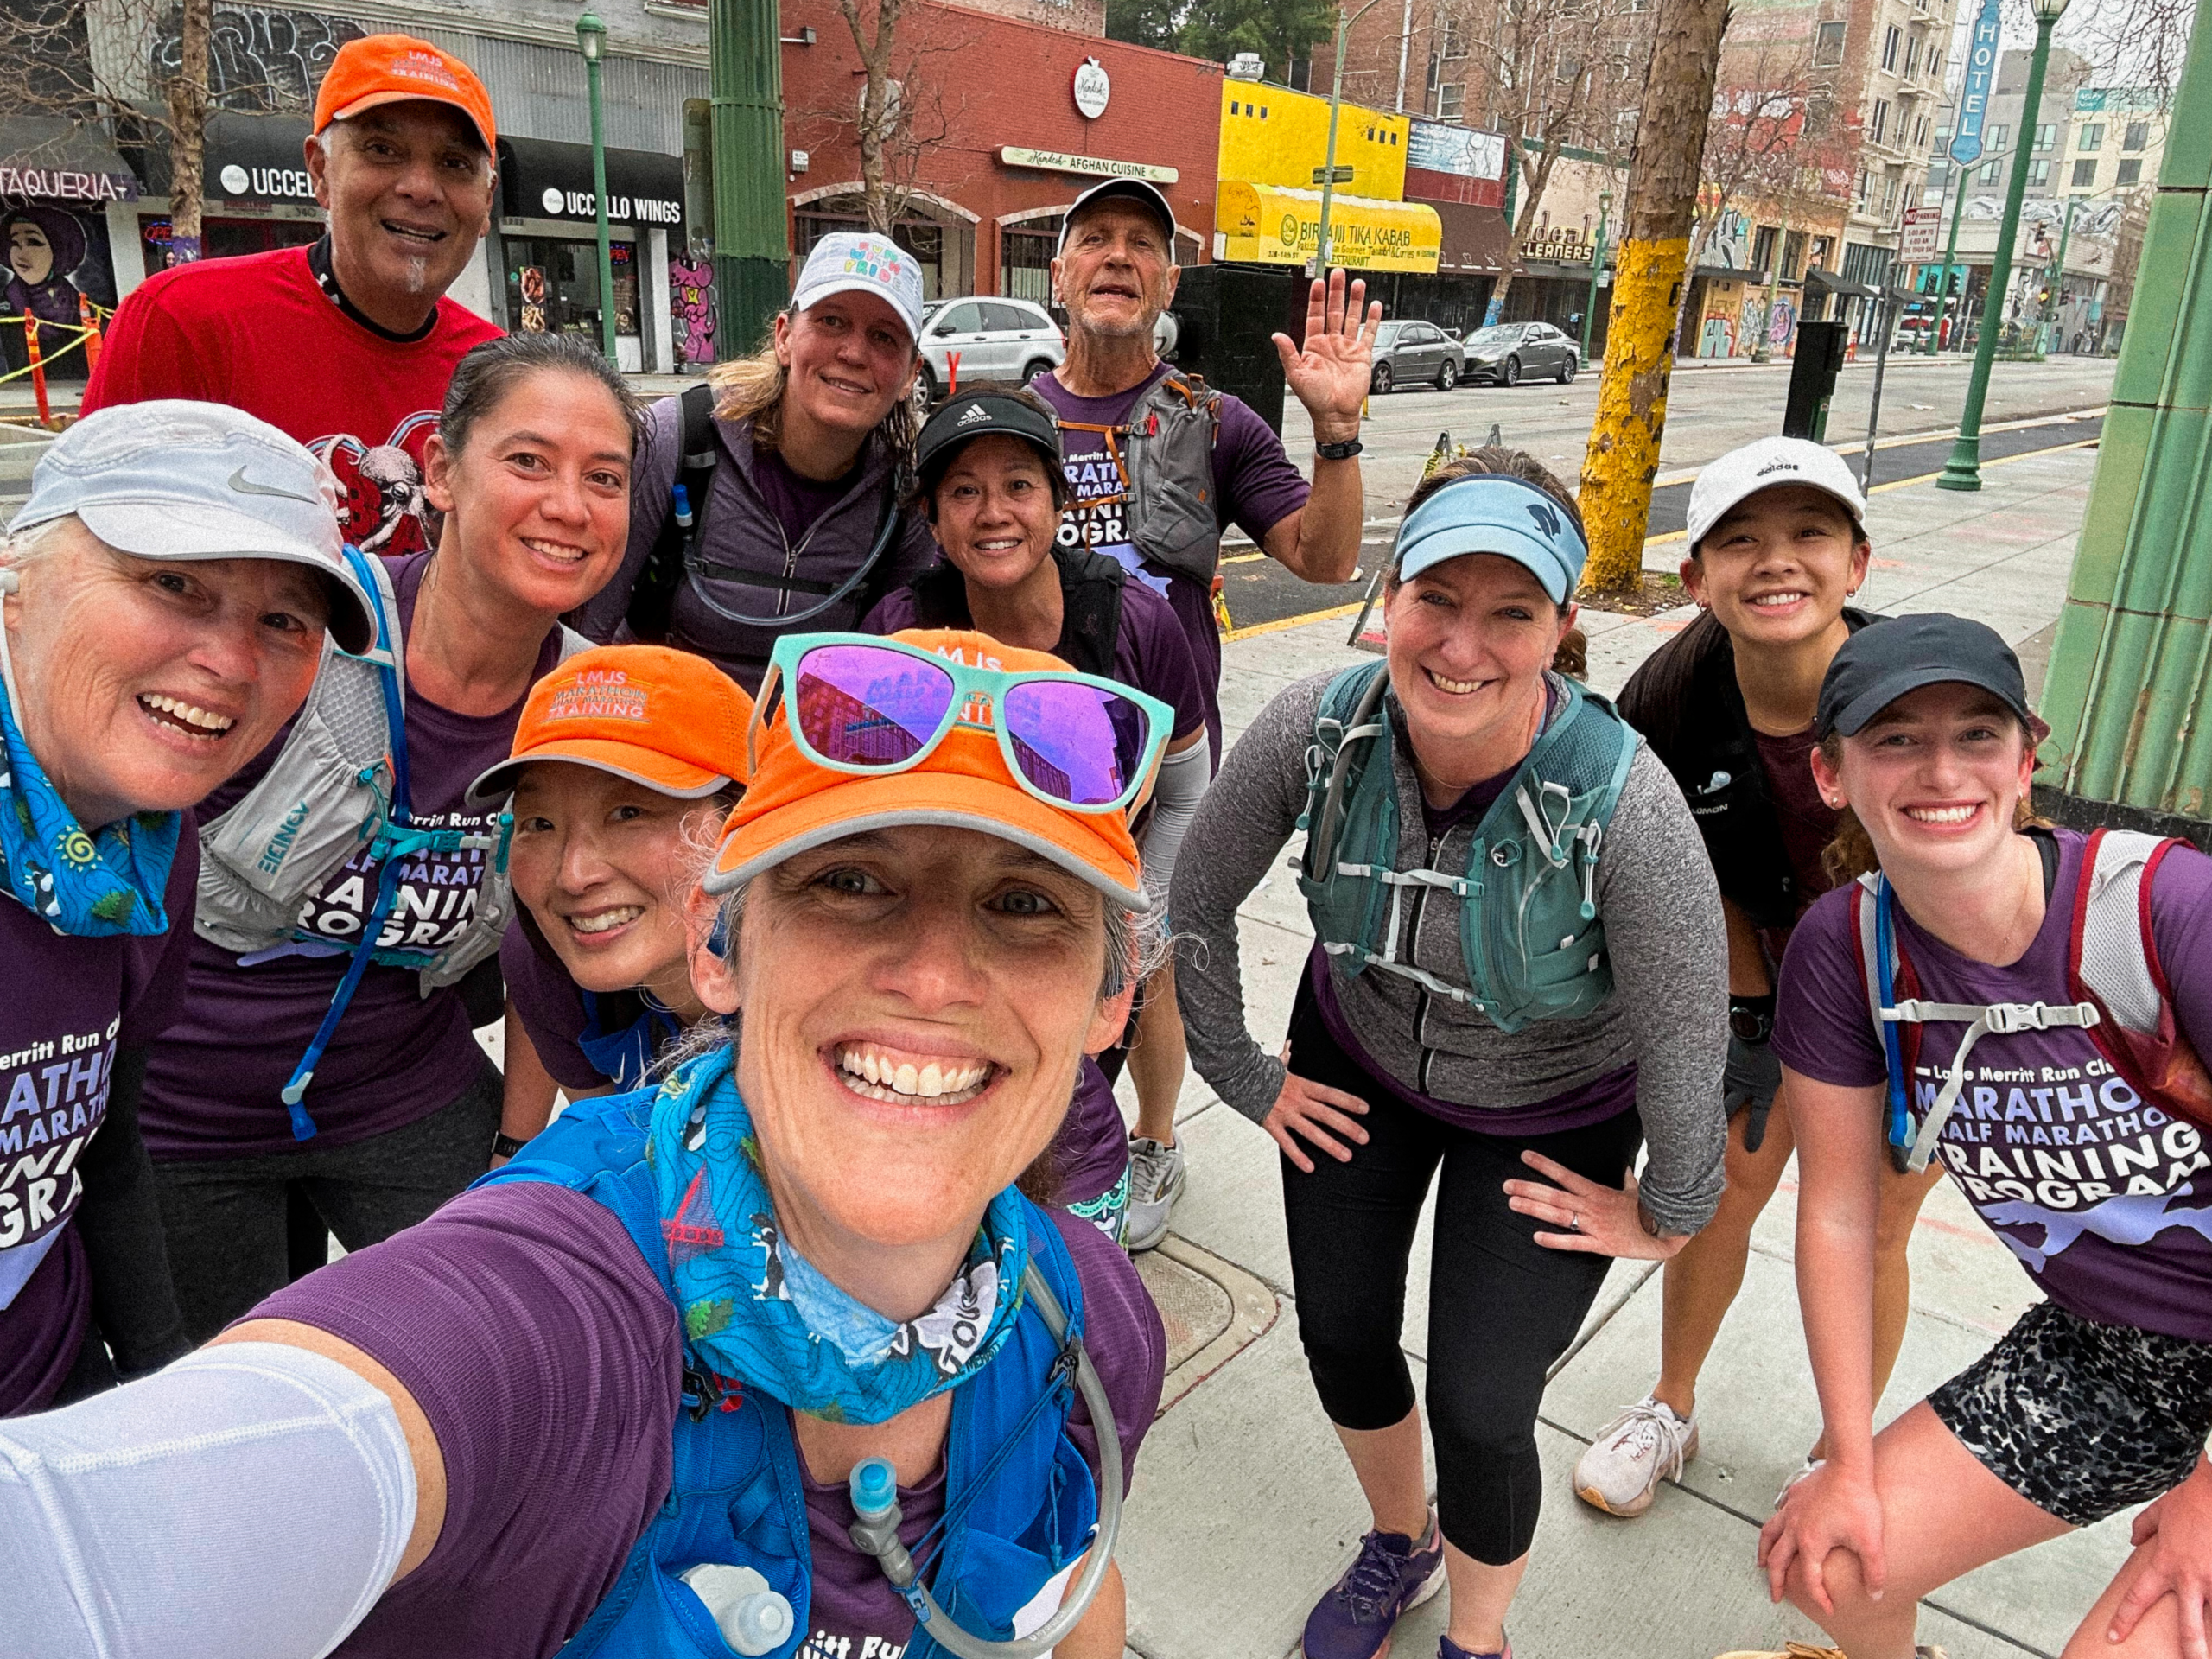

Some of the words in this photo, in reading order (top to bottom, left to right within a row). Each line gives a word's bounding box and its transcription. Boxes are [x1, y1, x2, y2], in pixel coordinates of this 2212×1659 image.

[409, 50, 442, 67] LMJS
[1961, 24, 1996, 137] HOTEL
[1070, 157, 1109, 173] AFGHAN
[1111, 162, 1146, 177] CUISINE
[252, 168, 316, 198] UCCEL
[566, 191, 631, 219] UCCLLO
[634, 198, 681, 224] WINGS
[1905, 212, 1916, 222] NO
[144, 226, 173, 240] OPE
[1300, 221, 1344, 243] BIRANI
[1349, 226, 1371, 245] TIKA
[1373, 227, 1410, 247] KABAB
[609, 249, 631, 260] PEN
[859, 241, 898, 261] RUN
[1331, 254, 1370, 266] ESTAURANT
[850, 248, 900, 275] WITH
[844, 259, 901, 291] PRIDE
[957, 415, 993, 427] adidas
[1069, 451, 1104, 462] Merritt
[1106, 451, 1125, 460] Rn
[1757, 464, 1799, 476] adidas
[937, 645, 1004, 672] MJS
[576, 670, 628, 685] LMJS
[553, 684, 648, 702] MARATHON
[582, 695, 646, 708] MARATHON
[549, 702, 645, 718] TRAINING
[450, 812, 481, 827] Run
[1691, 804, 1728, 815] LOMON
[297, 899, 470, 948] ROGRA
[0, 1041, 54, 1071] erritt
[61, 1032, 99, 1055] Run
[1934, 1065, 1974, 1082] Lae
[1980, 1066, 2035, 1082] Merritt
[2042, 1066, 2081, 1082] Run
[2086, 1058, 2116, 1077] Clu
[1915, 1077, 2142, 1122] MARATHO
[2005, 1105, 2169, 1146] MARATHO
[859, 1636, 910, 1659] Ru
